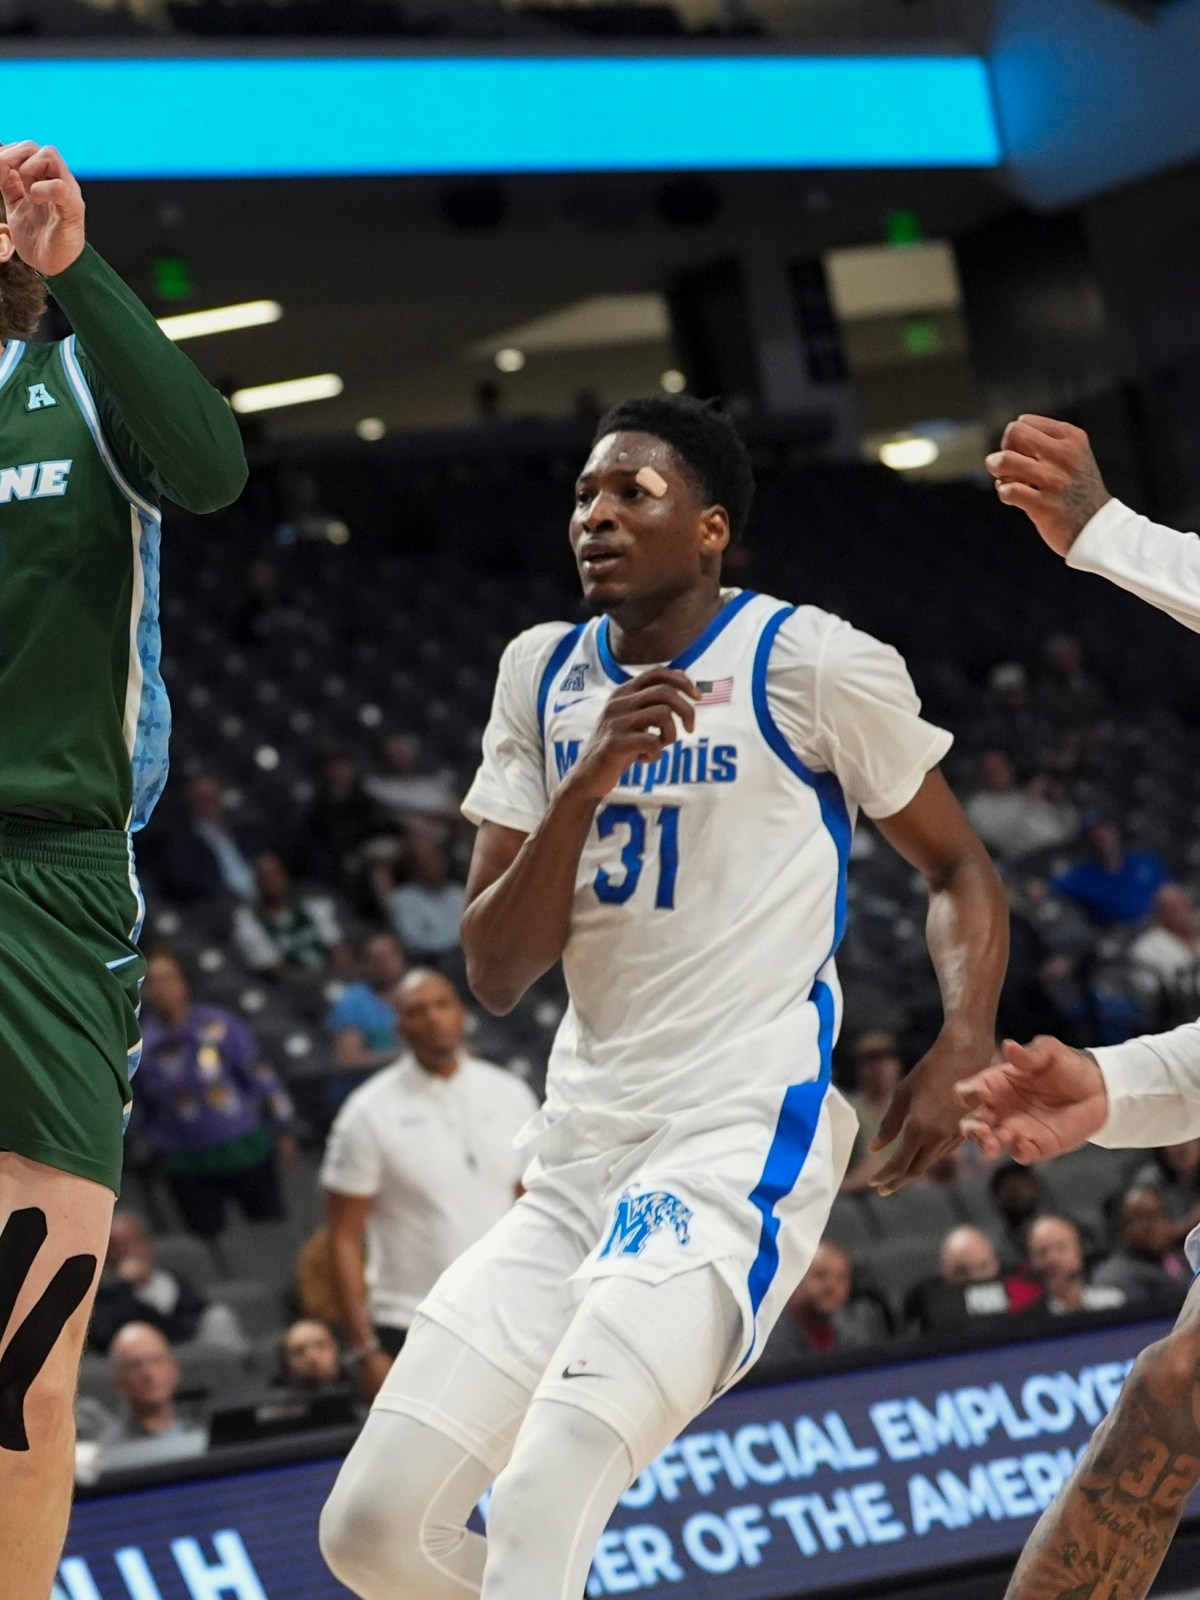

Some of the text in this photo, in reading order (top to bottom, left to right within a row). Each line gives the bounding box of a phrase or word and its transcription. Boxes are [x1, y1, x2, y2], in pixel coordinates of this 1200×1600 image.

[27, 383, 57, 410] A
[554, 737, 737, 794] Mphis
[593, 803, 681, 910] 31
[869, 1359, 1135, 1461] EMPLOYE
[586, 1441, 1091, 1597] ER OF THE AMERI
